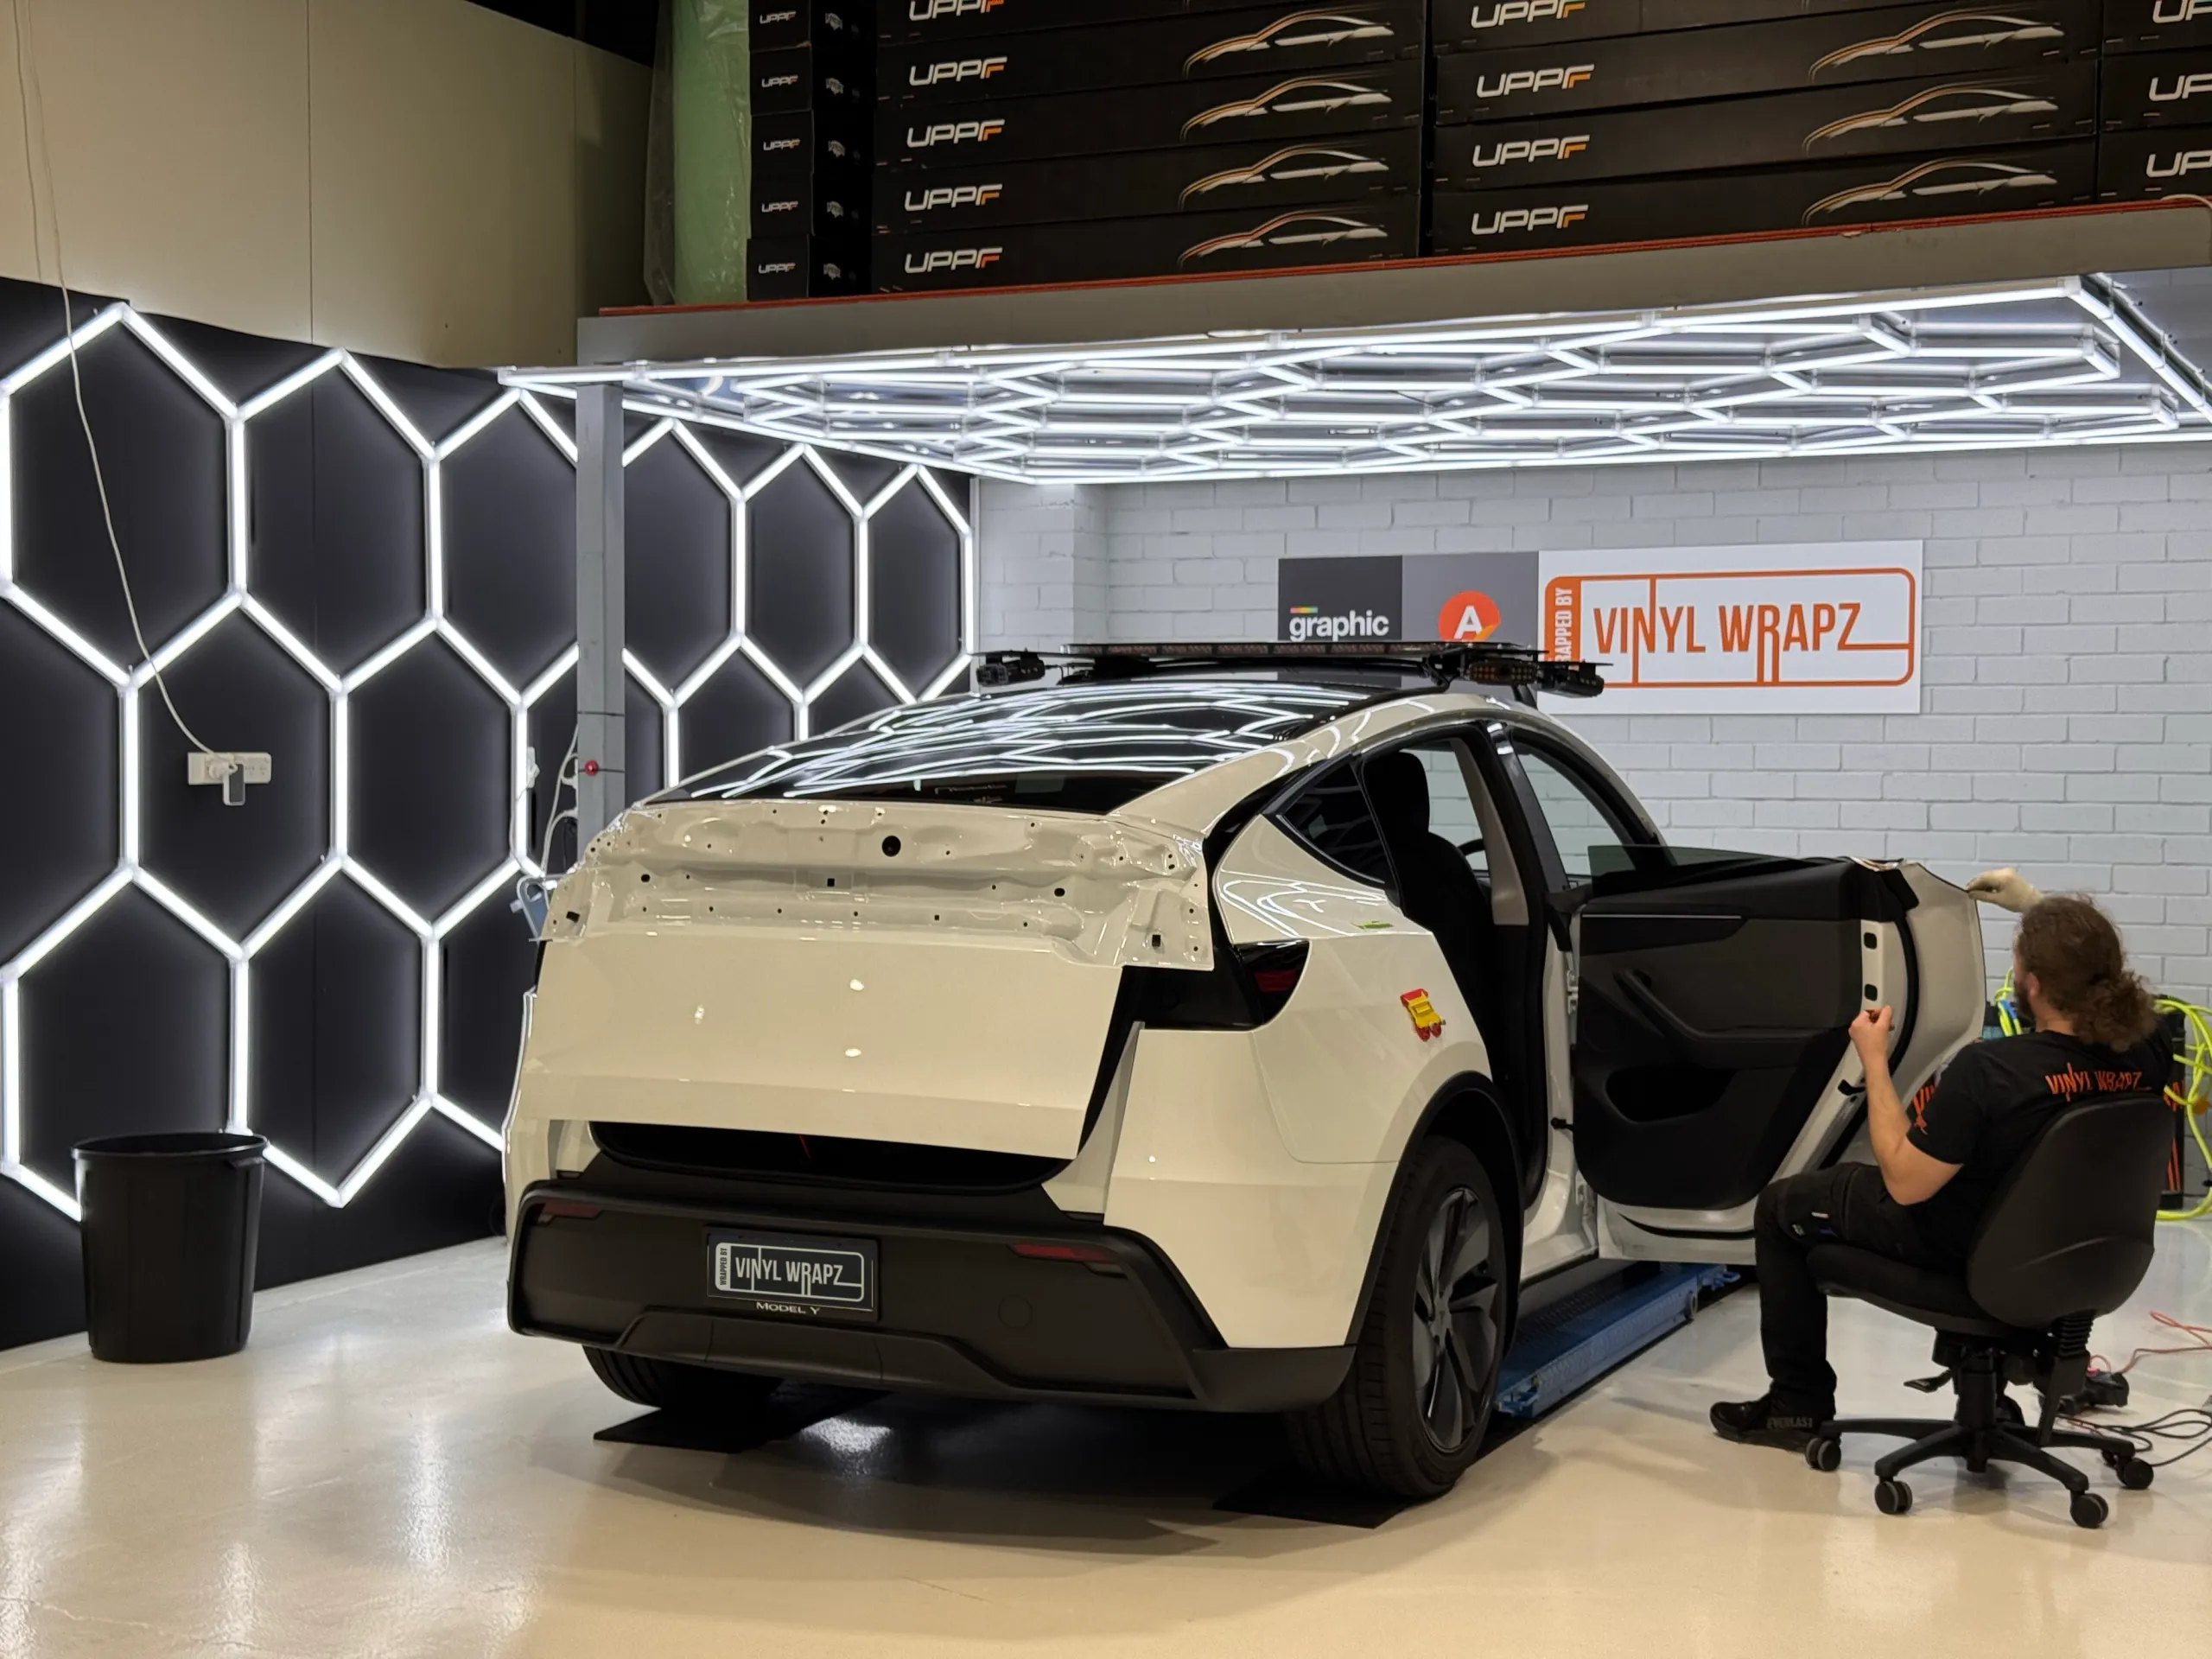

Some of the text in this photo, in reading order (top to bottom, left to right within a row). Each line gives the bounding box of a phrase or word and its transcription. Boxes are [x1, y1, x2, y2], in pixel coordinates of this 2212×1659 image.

[760, 11, 796, 23] UPPF
[909, 0, 1004, 21] UPPF
[1471, 0, 1585, 28] UPPF
[2153, 0, 2212, 23] UP
[762, 75, 798, 87] UPPF
[910, 57, 1007, 86] UPPF
[1477, 65, 1594, 97] UPPF
[2149, 73, 2212, 101] UP
[764, 139, 800, 150] UPPF
[907, 119, 1005, 147] UPPF
[1473, 135, 1590, 167] UPPF
[2146, 150, 2212, 177] UP
[762, 201, 798, 212] UPPF
[905, 184, 1002, 211] UPPF
[1471, 205, 1588, 234] UPPF
[759, 263, 795, 273] UPPF
[905, 247, 1002, 273] UPPF
[1289, 610, 1389, 641] graphic
[1554, 587, 1573, 662] RAPPED BY
[1592, 602, 1861, 681] VINYL WRAPZ
[2045, 1063, 2092, 1102] VINYL
[735, 1256, 843, 1296] VINYL WRAPZ
[756, 1302, 806, 1313] MODEL
